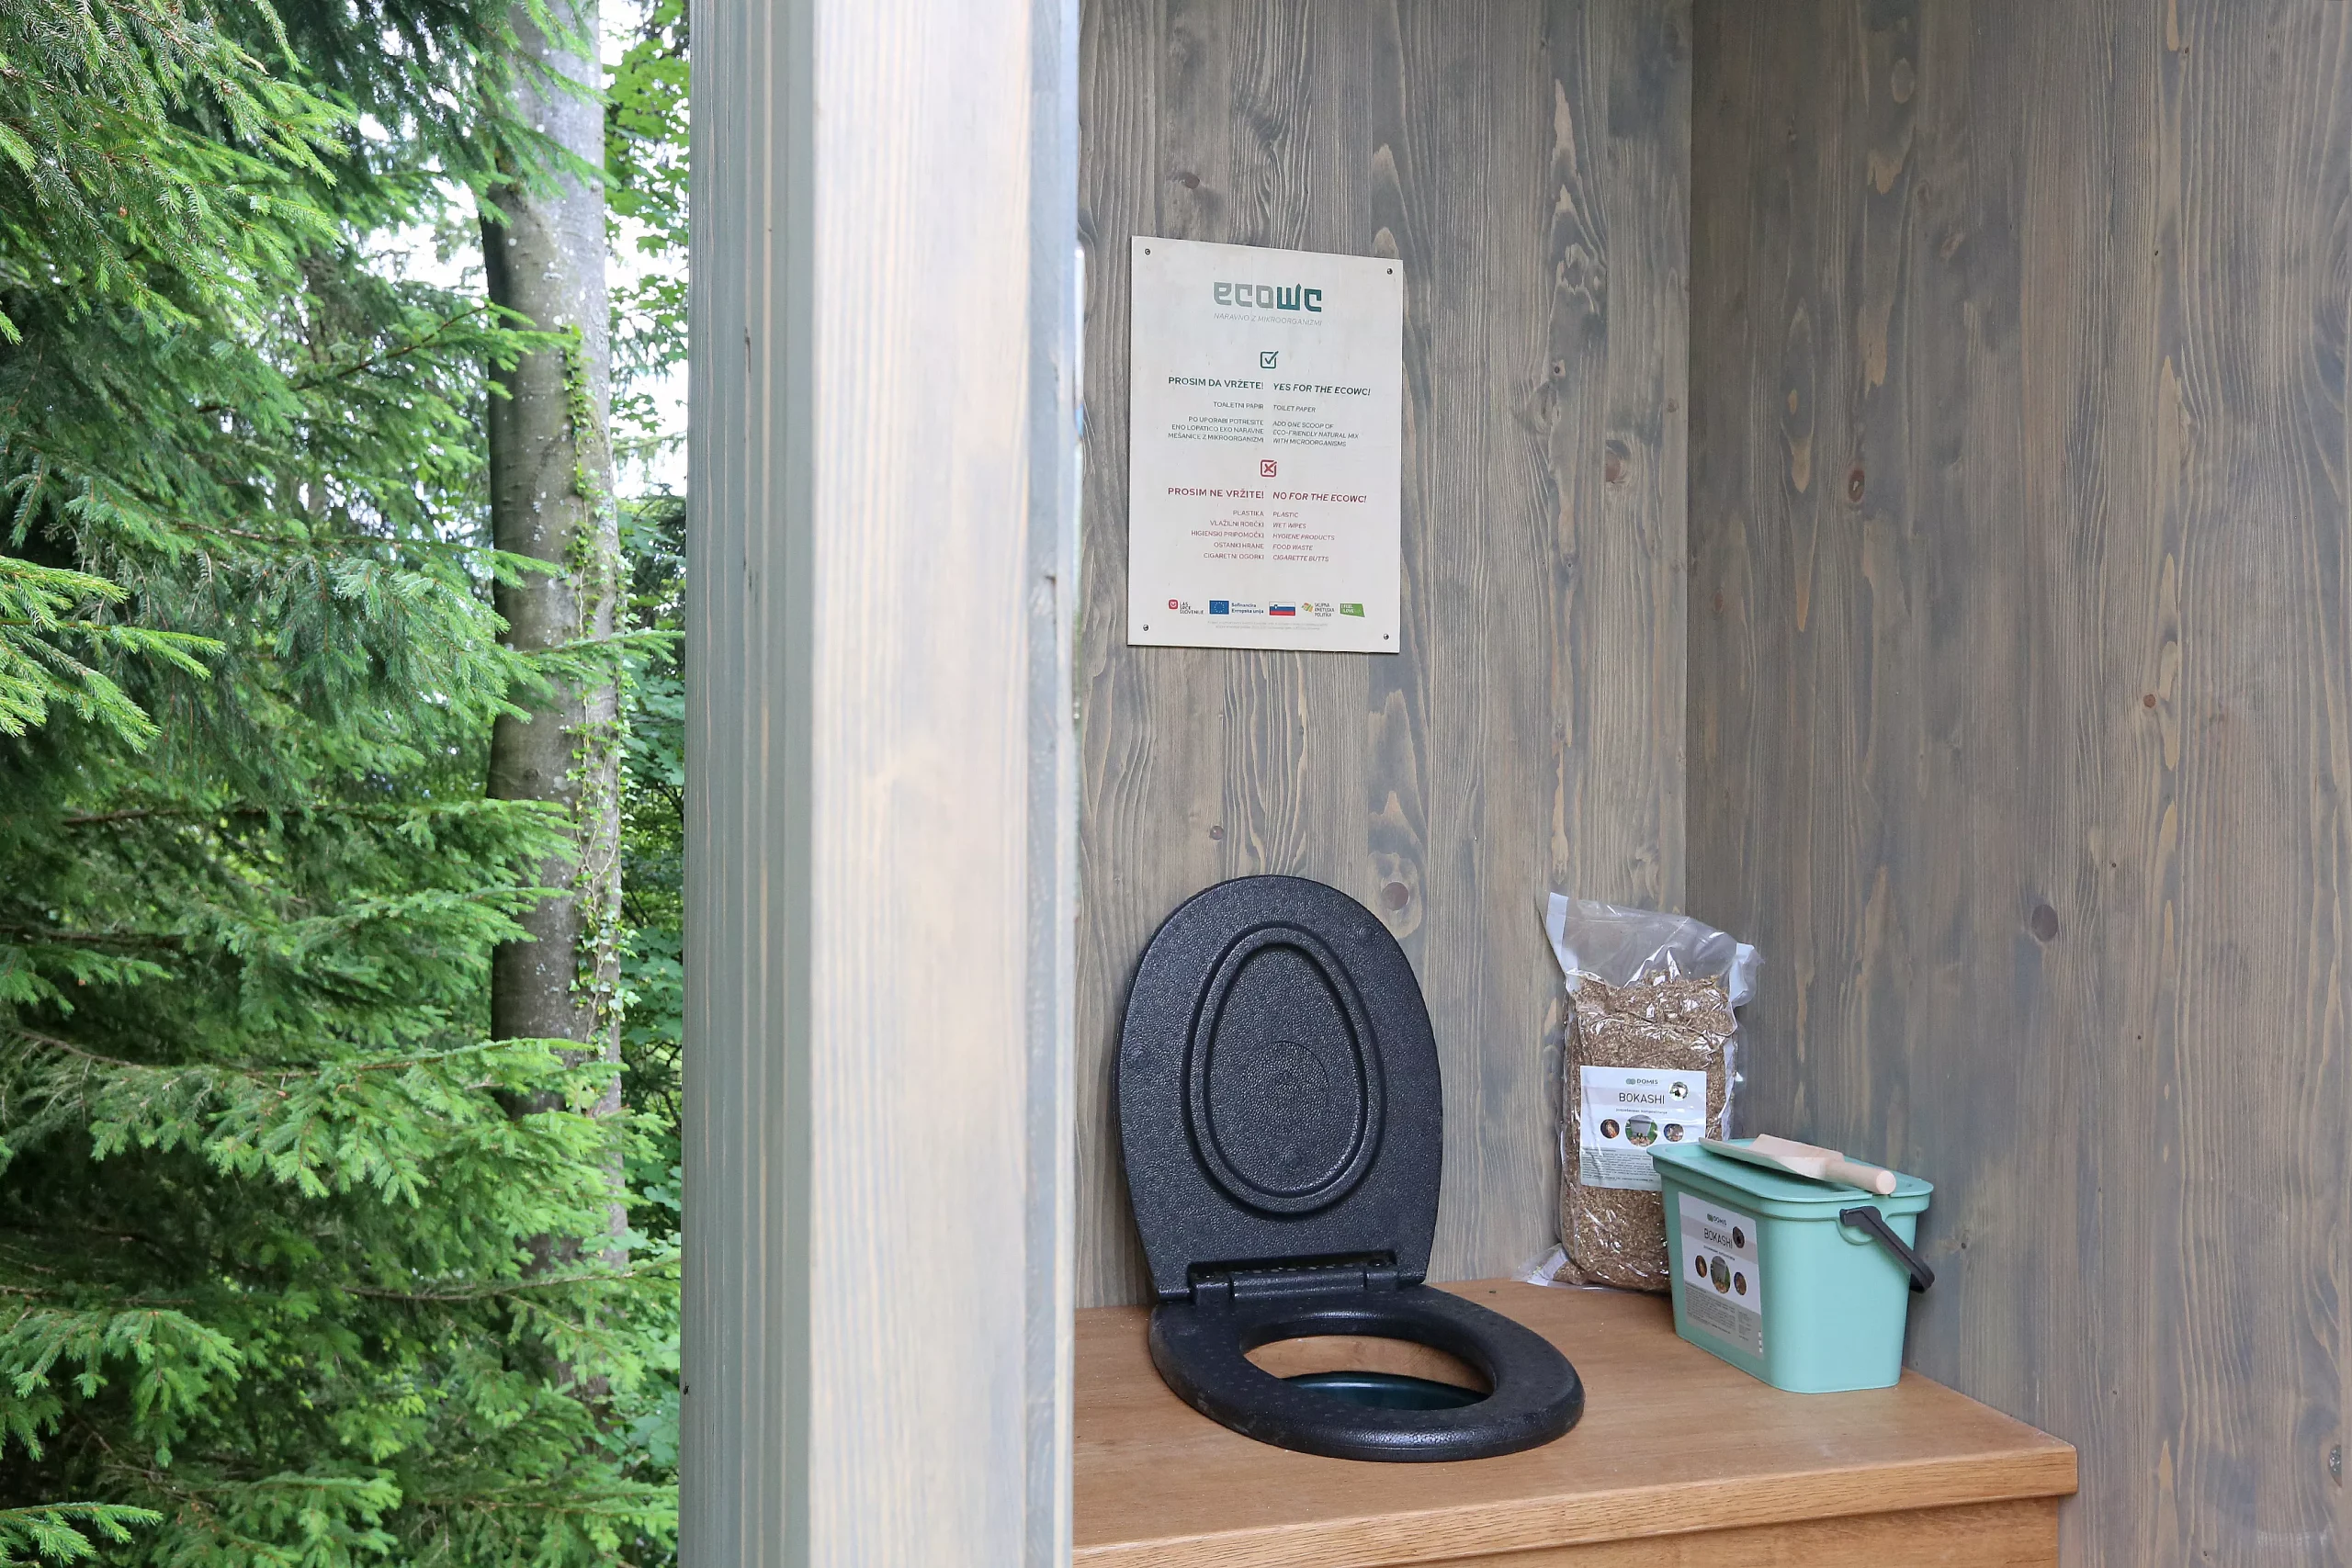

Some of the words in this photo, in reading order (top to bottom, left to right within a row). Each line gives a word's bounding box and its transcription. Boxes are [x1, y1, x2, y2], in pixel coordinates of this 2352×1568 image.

[1214, 312, 1250, 321] NARAVNO
[1257, 316, 1322, 326] MIKROORGANIZMI
[1169, 377, 1206, 386] PROSIM
[1208, 378, 1222, 387] DA
[1224, 378, 1264, 389] VRŽETE!
[1273, 383, 1291, 391] YES
[1293, 384, 1312, 392] FOR
[1315, 385, 1333, 393] THE
[1334, 387, 1371, 396] ECOWC!
[1207, 434, 1264, 443] MIKROORGANIZMI
[1272, 429, 1317, 437] ECO-FRIENDLY
[1168, 487, 1207, 496] PROSIM
[1210, 489, 1223, 497] NE
[1226, 489, 1264, 499] VRŽITE!
[1272, 491, 1287, 500] NO
[1288, 492, 1308, 501] FOR
[1311, 493, 1329, 502] THE
[1330, 494, 1367, 503] ECOWC!
[1619, 1092, 1665, 1104] BOKASHI
[1703, 1228, 1733, 1249] BOKASHI
